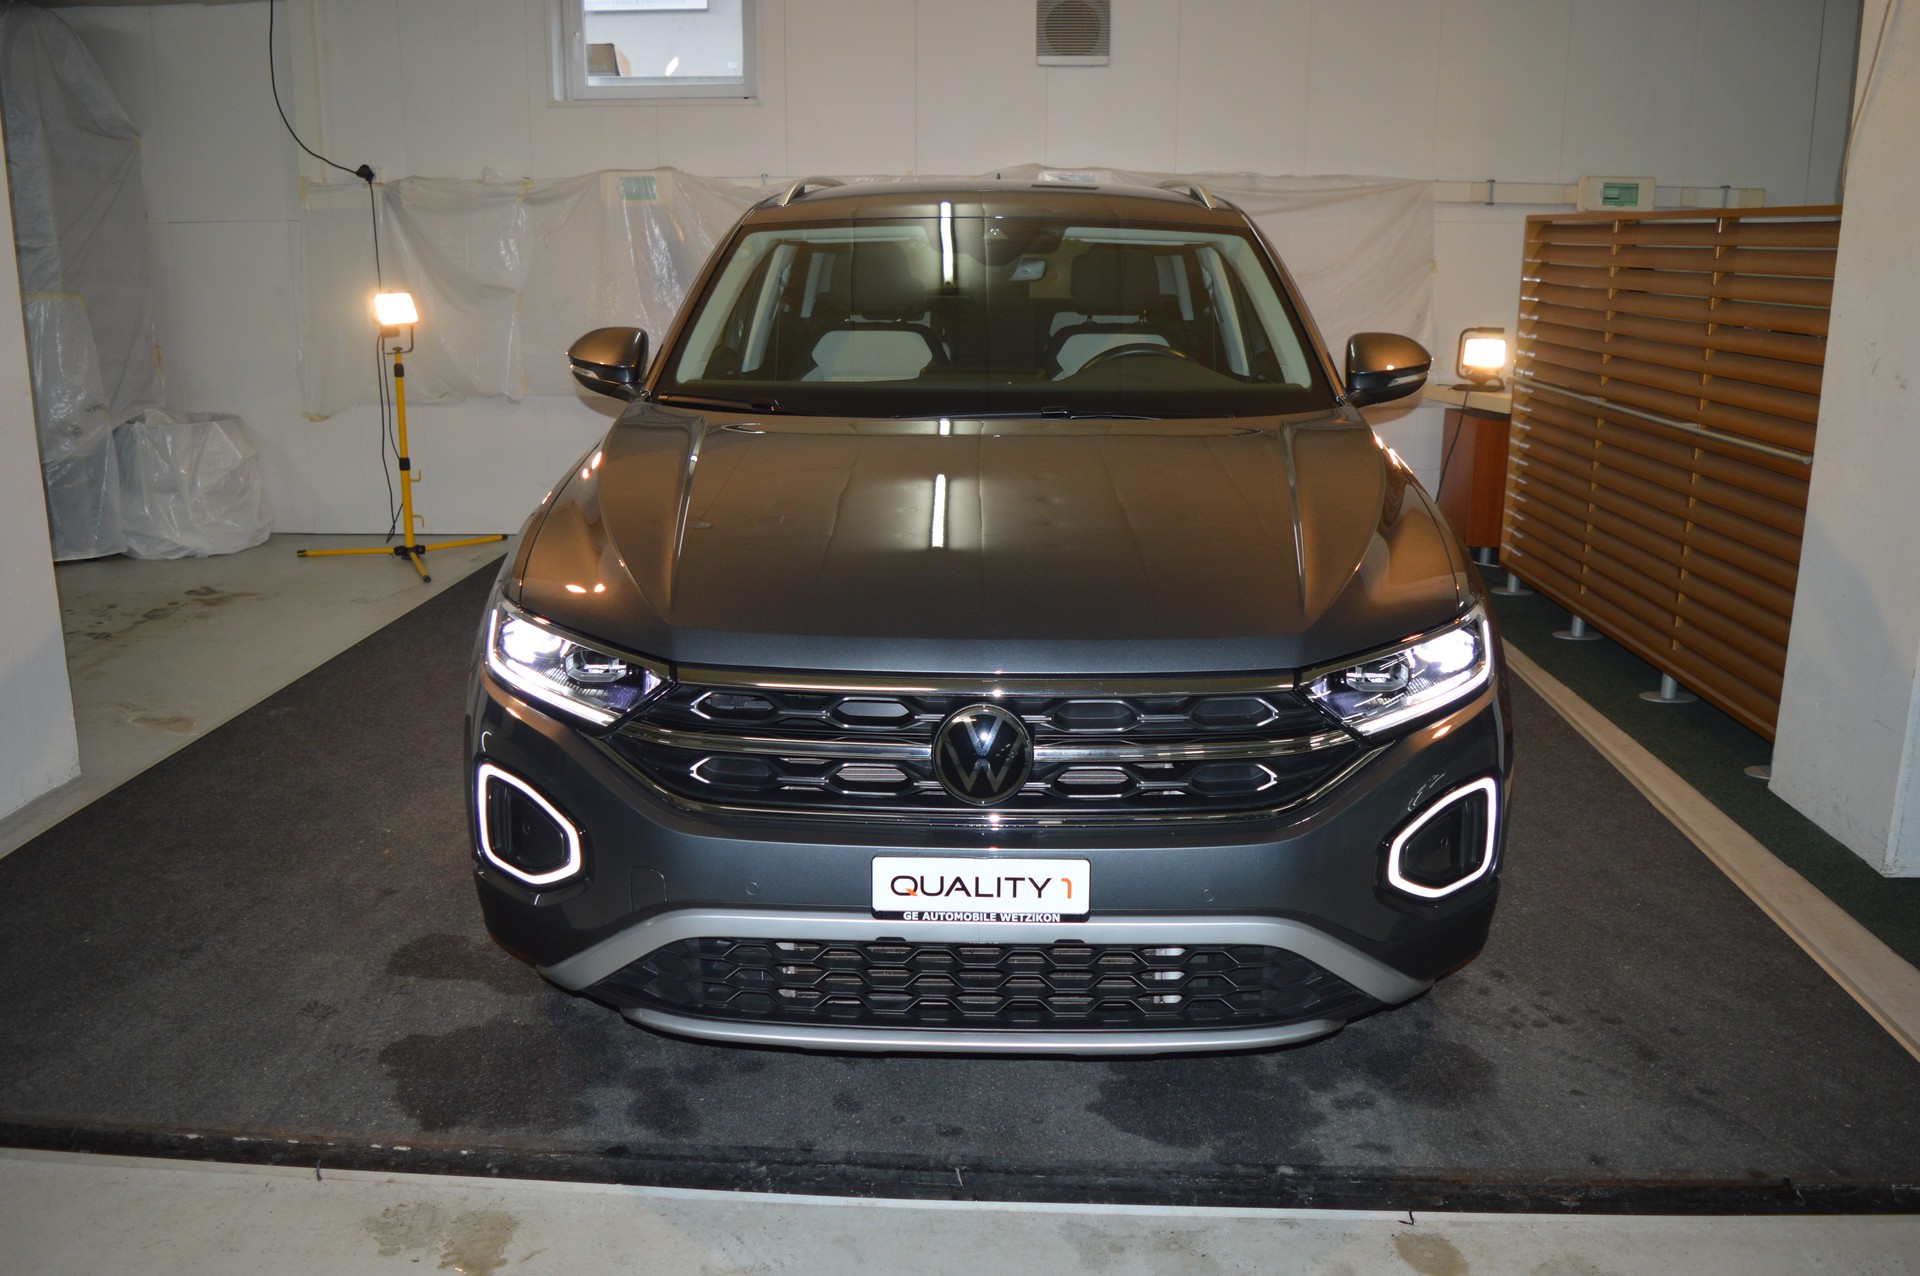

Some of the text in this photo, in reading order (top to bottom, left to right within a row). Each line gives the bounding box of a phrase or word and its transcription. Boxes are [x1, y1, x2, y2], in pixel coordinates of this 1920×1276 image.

[890, 875, 1072, 899] QUALITY 1
[903, 911, 1061, 923] GE AUTOMOBILE WETZIKON
